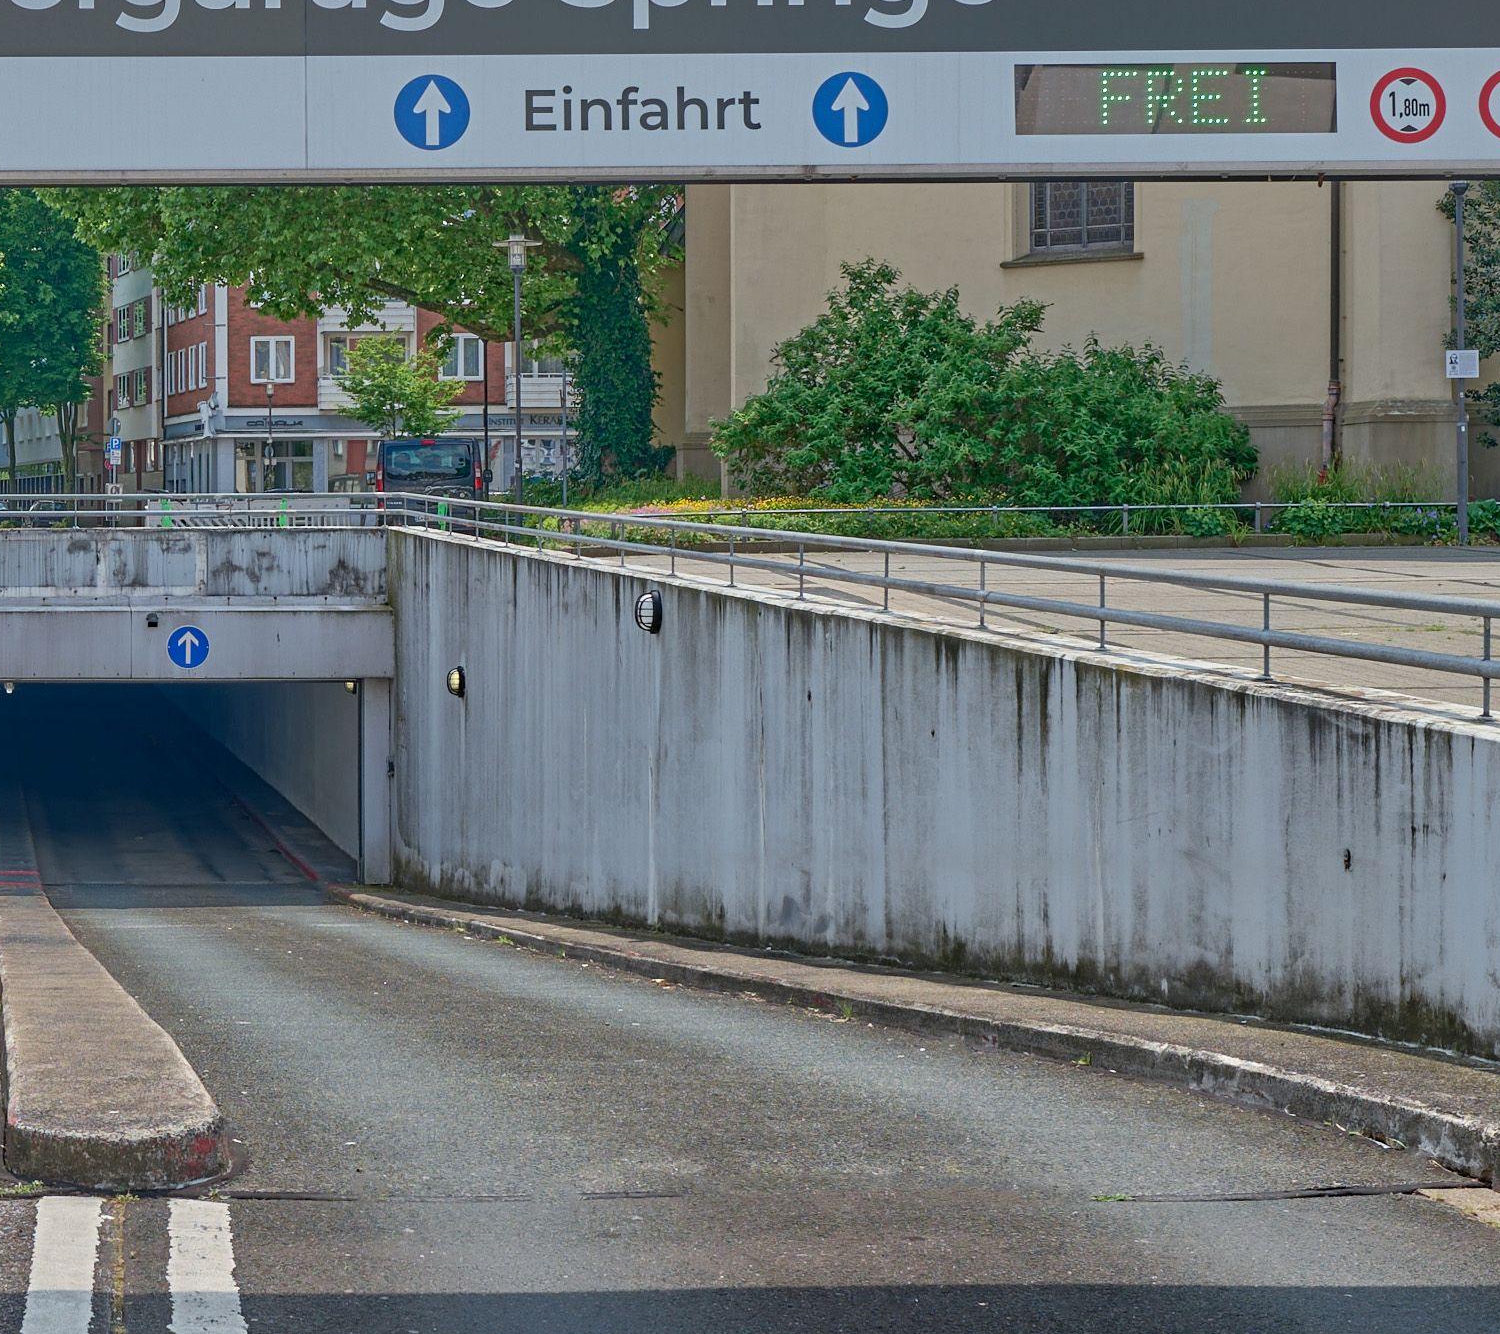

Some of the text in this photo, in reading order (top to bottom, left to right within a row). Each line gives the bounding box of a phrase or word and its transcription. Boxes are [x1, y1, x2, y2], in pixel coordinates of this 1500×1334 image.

[524, 85, 763, 133] Einfahrt
[1101, 69, 1267, 125] FREI
[1389, 91, 1430, 119] 1,80m
